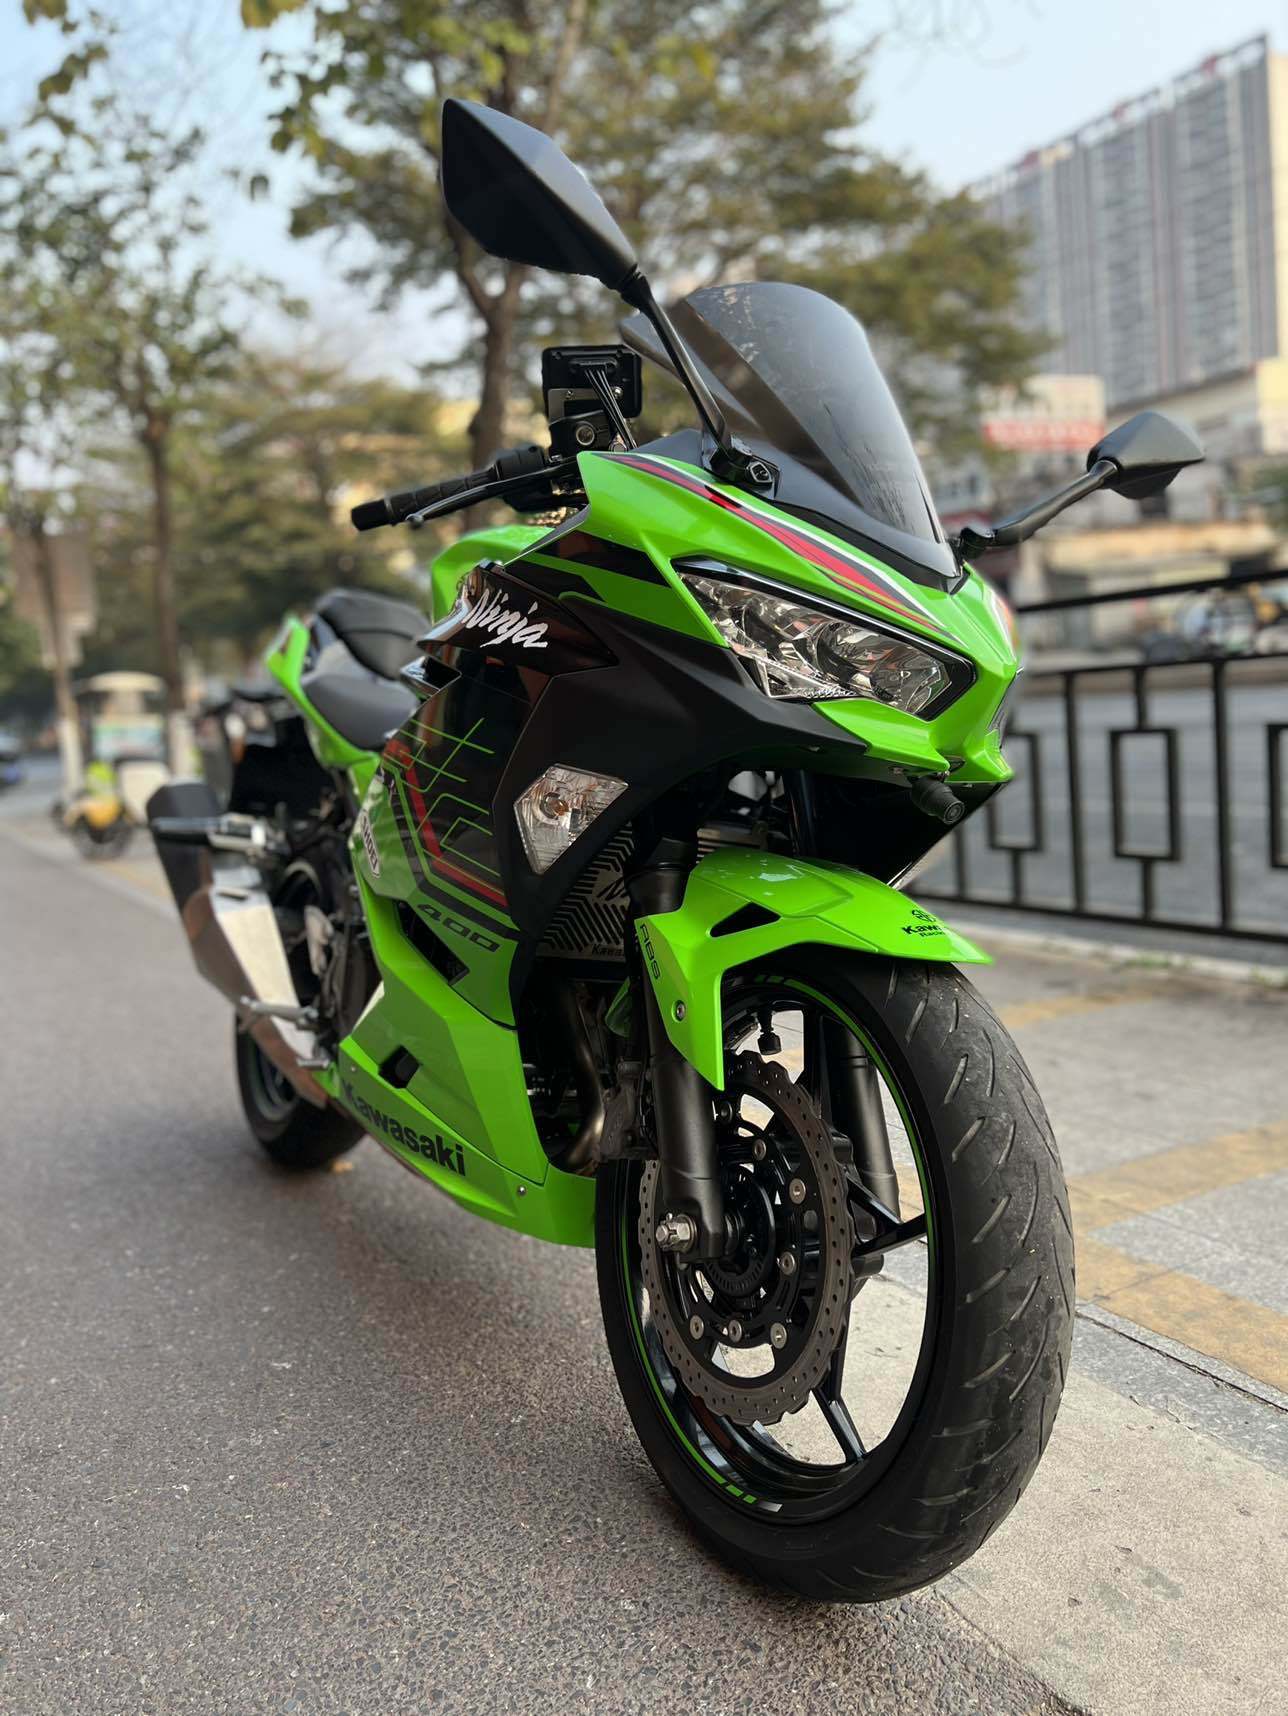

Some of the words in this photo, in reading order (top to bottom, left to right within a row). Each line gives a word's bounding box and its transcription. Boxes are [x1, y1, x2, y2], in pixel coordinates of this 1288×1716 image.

[461, 588, 549, 649] Ninja
[416, 903, 501, 953] 400
[640, 923, 661, 980] ABS
[341, 1078, 466, 1177] Kawasaki
